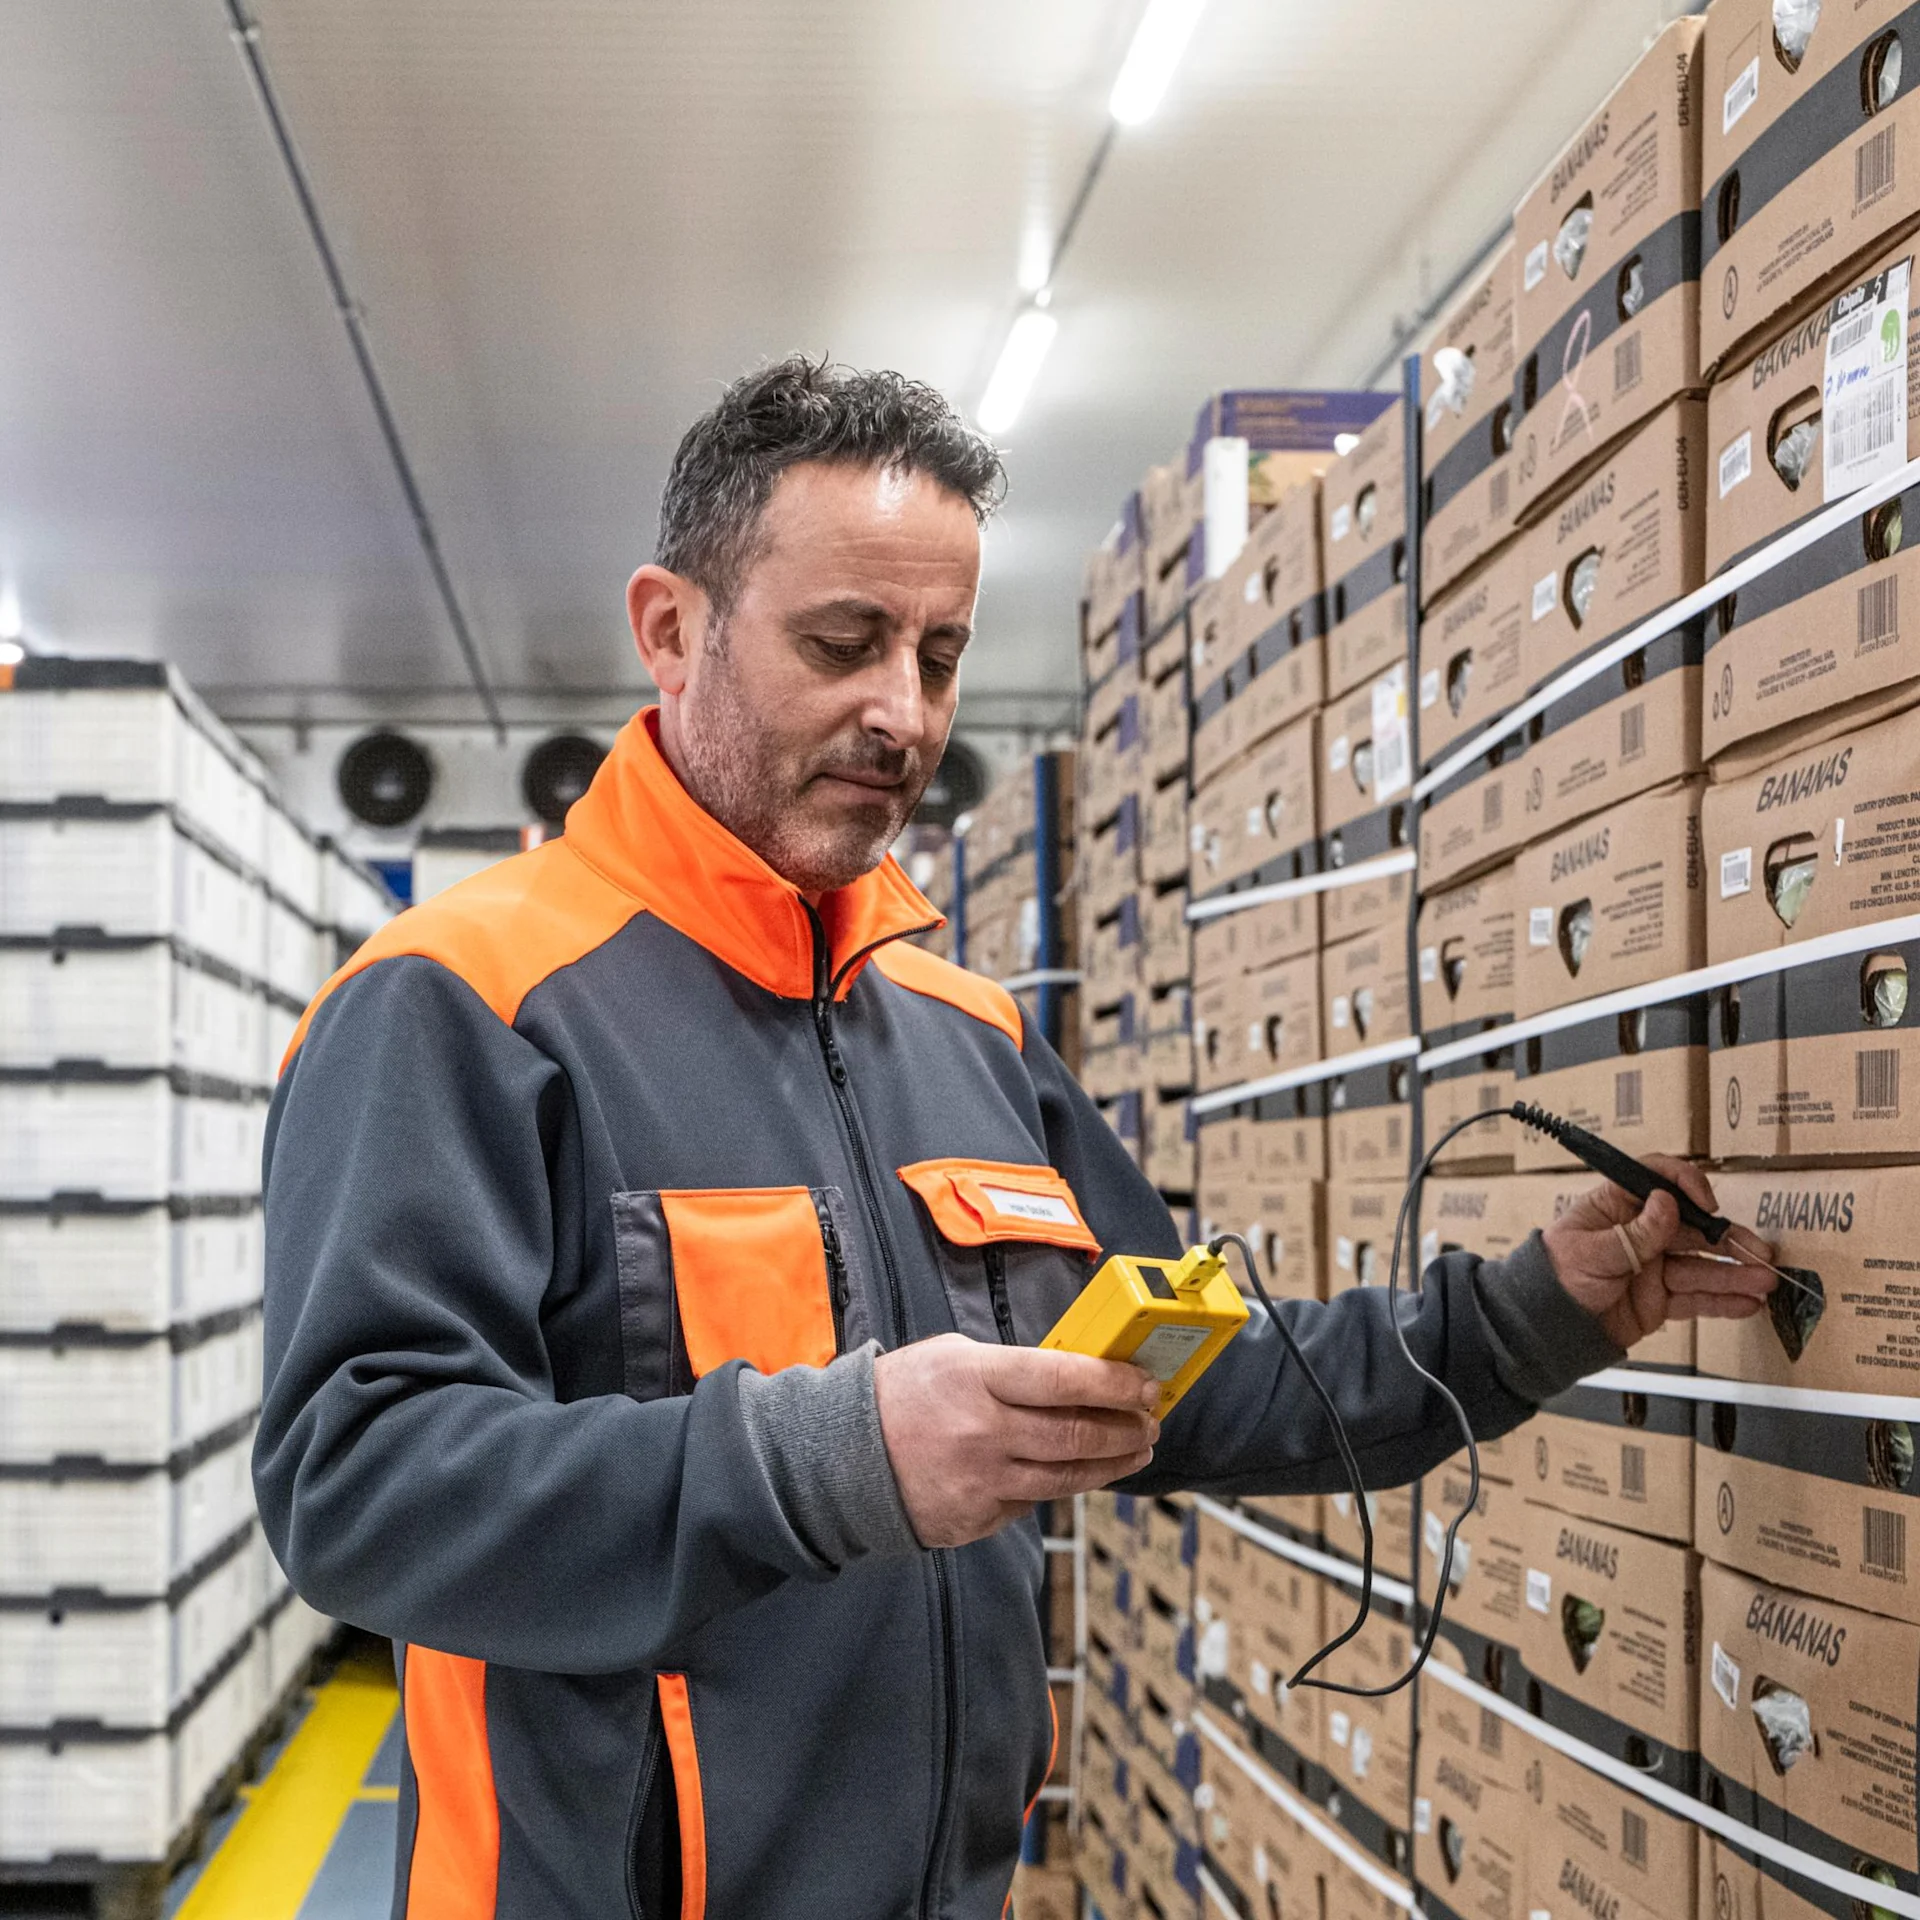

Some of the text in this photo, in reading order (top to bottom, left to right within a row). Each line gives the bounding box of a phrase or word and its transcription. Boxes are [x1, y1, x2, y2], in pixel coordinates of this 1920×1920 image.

[1551, 111, 1610, 204] BANANAS
[1752, 305, 1832, 390] BANANA
[1557, 471, 1615, 544] BANANAS
[1756, 747, 1853, 812] BANANAS
[1550, 827, 1610, 882] BANANAS
[1756, 1191, 1854, 1233] BANANAS
[1556, 1527, 1619, 1580] BANANAS
[1746, 1593, 1847, 1667] BANANAS
